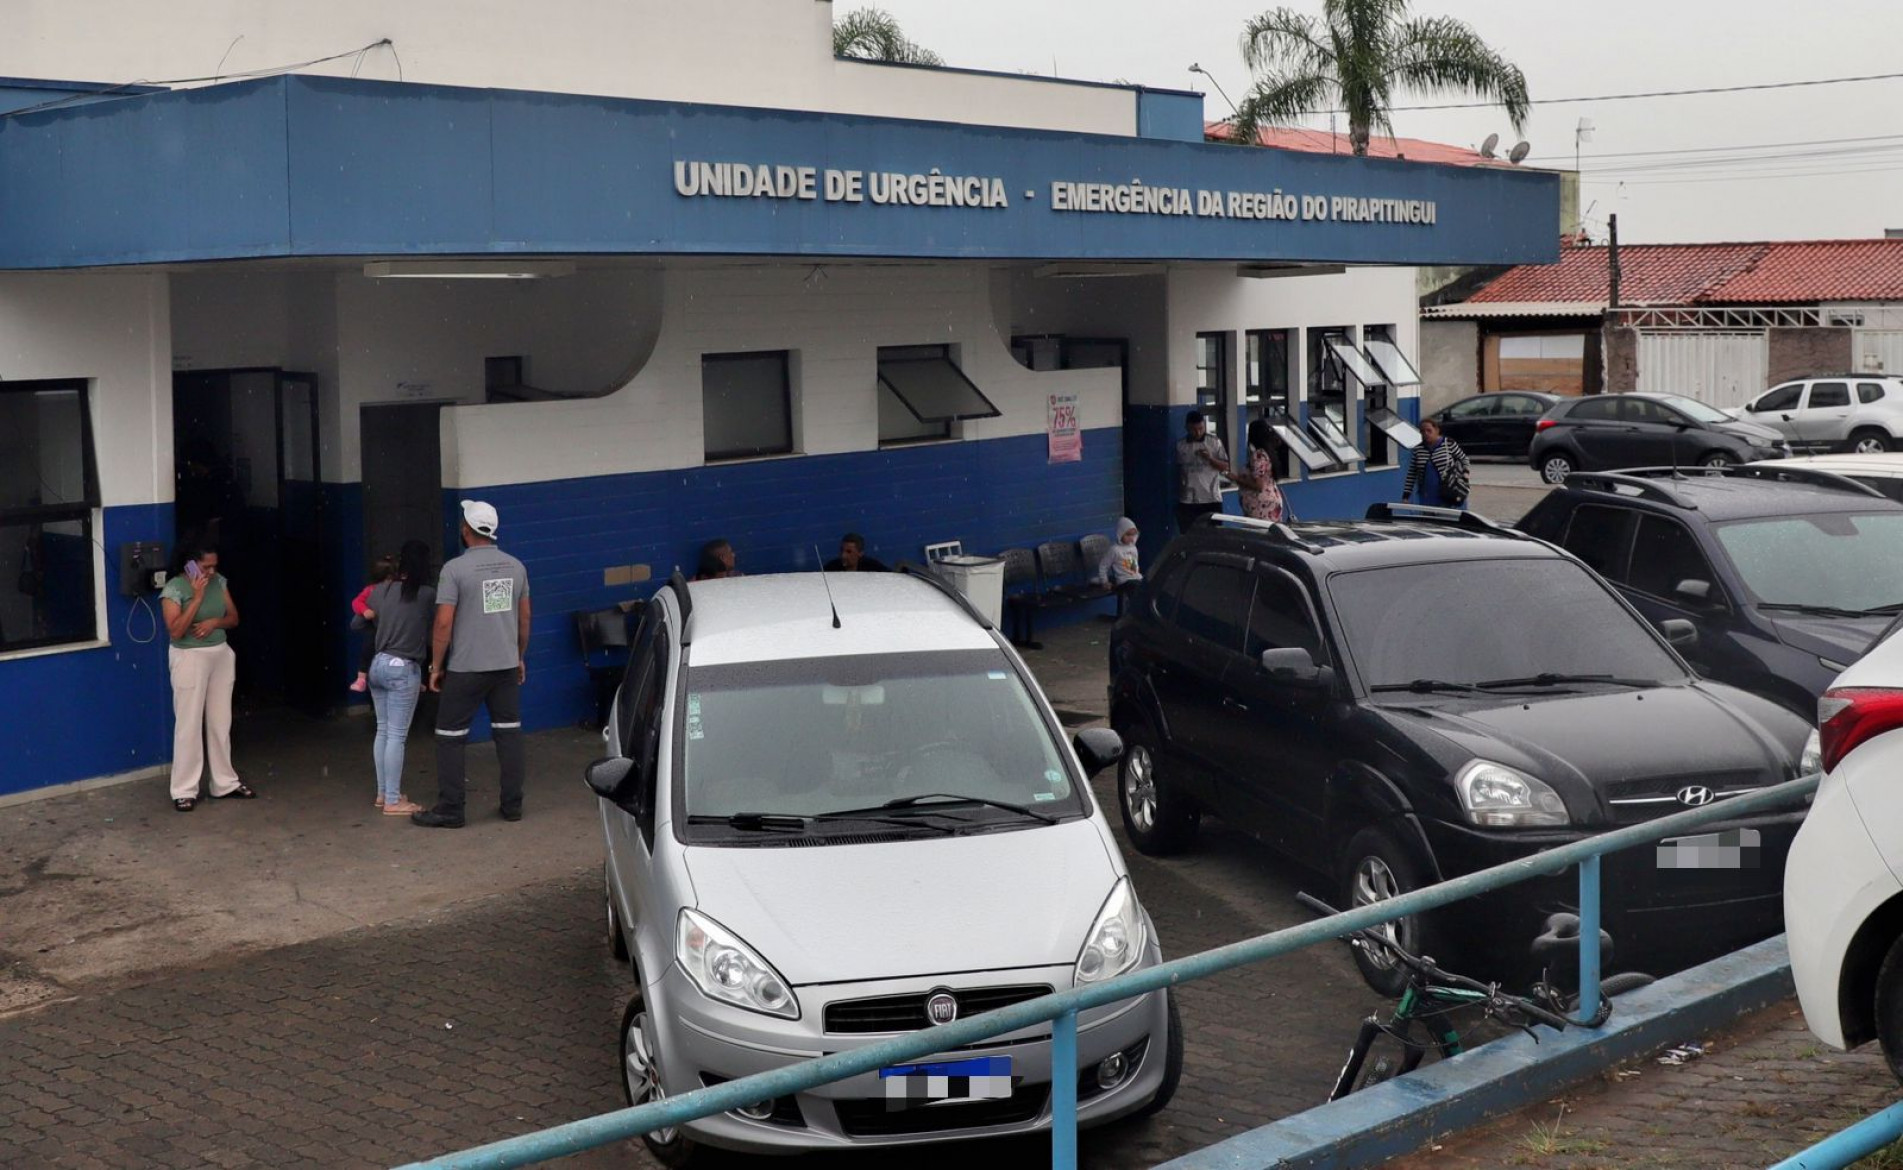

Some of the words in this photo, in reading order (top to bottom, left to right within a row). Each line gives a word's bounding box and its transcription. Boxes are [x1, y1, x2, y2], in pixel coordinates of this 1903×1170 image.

[674, 160, 817, 199] UNIDADE
[824, 169, 863, 202] DE
[869, 167, 1008, 208] URGÊNCIA
[1051, 178, 1193, 215] EMERGÊNCIA
[1197, 190, 1225, 217] DA
[1227, 188, 1298, 221] REGIÃO
[1301, 195, 1328, 221] DO
[1331, 196, 1437, 224] PIRAPITINGUI
[1053, 406, 1076, 428] 75%
[934, 1003, 951, 1019] FIAT
